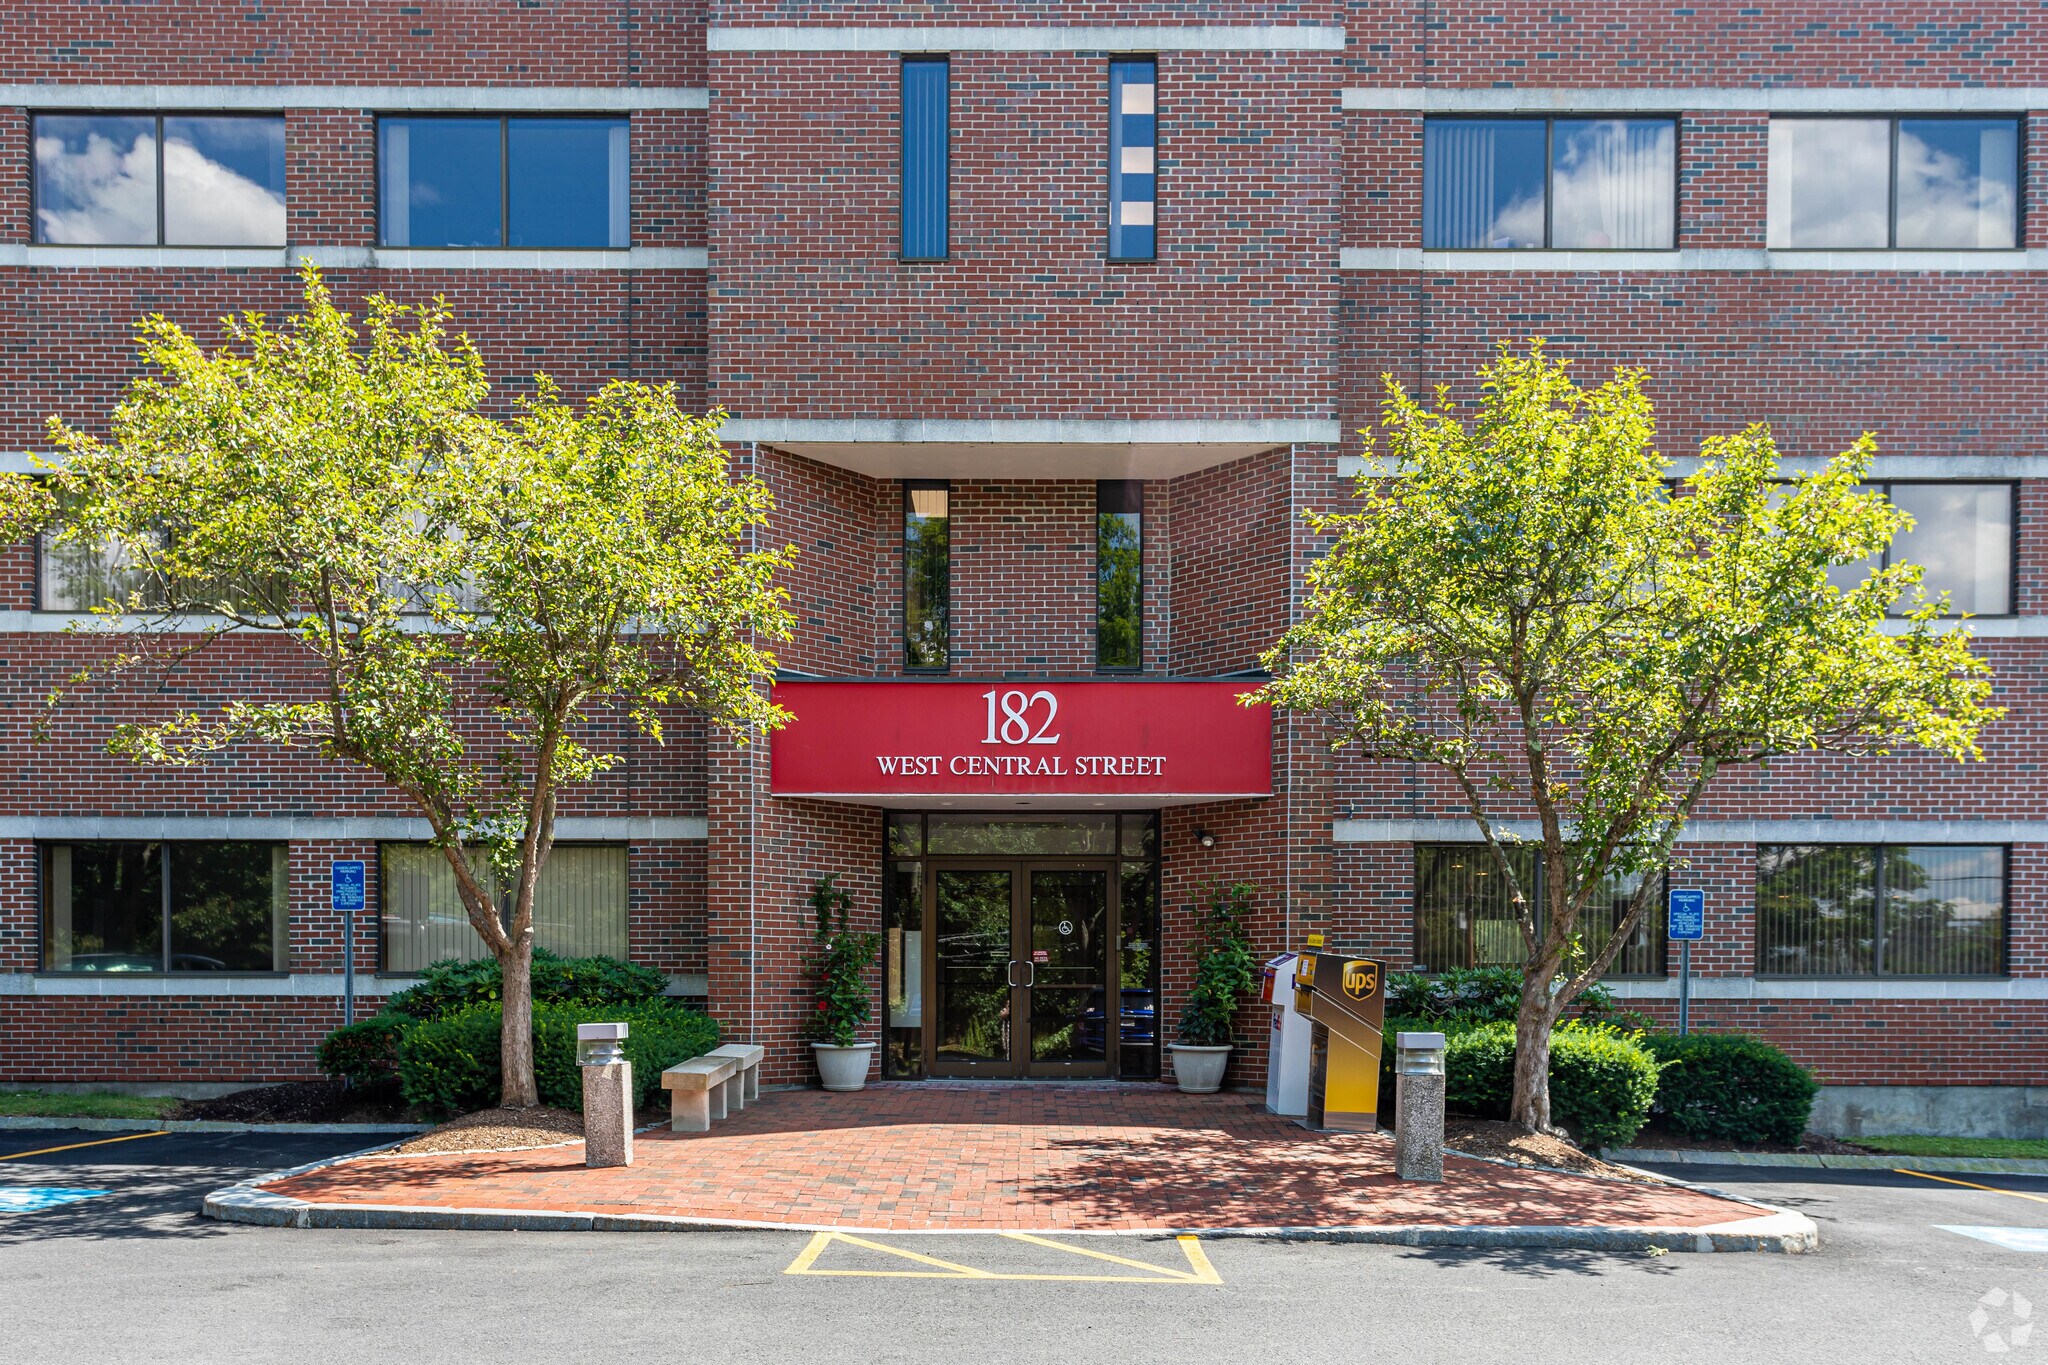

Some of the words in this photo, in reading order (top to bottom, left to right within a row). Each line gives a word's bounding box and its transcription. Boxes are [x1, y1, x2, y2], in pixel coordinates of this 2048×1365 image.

[980, 690, 1061, 745] 182
[876, 756, 942, 776] WEST
[949, 756, 1068, 776] CENTRAL
[1075, 756, 1167, 776] STREET
[1345, 973, 1375, 995] ups
